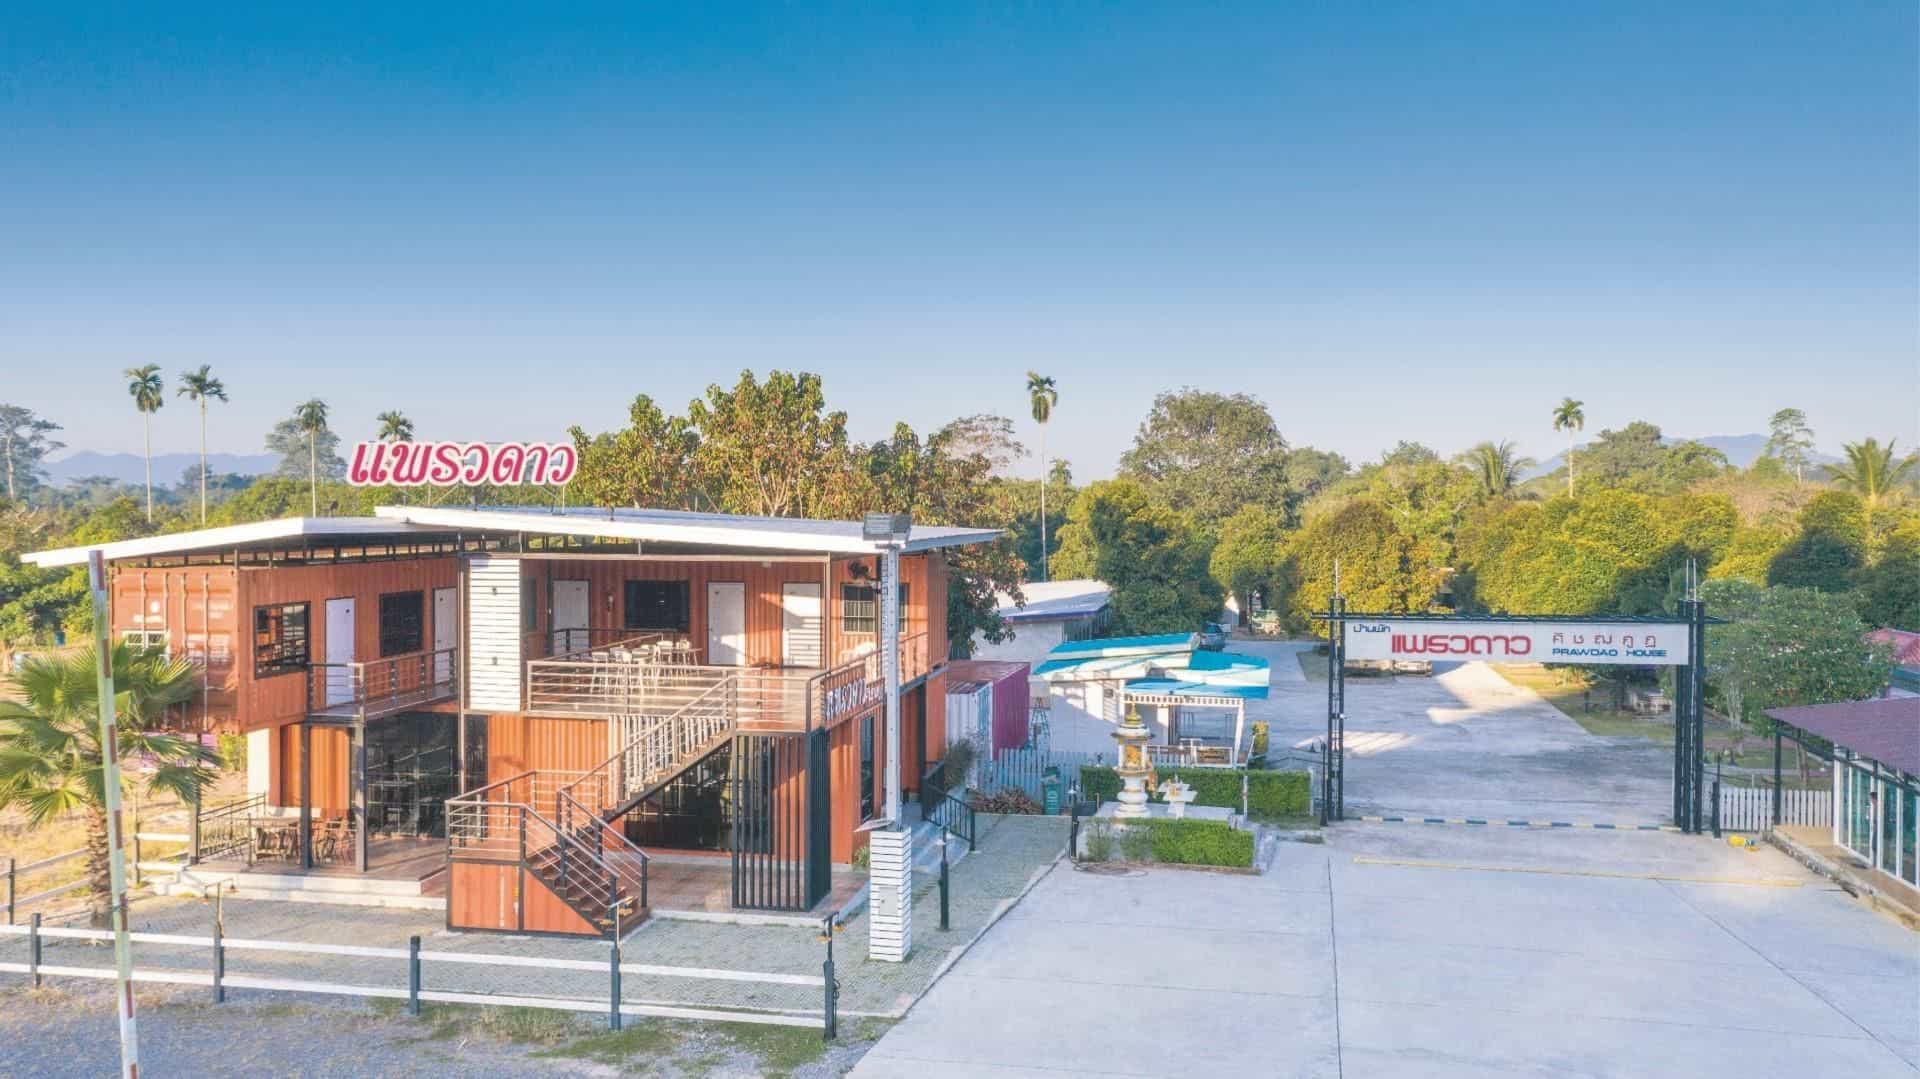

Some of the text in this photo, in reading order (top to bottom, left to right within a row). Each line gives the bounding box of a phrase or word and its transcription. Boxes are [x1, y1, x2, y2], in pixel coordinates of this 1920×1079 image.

[349, 442, 577, 484] แพรวดาว
[1391, 634, 1531, 655] แพรวดาว
[1552, 648, 1666, 657] PRAWDAO HOUSE
